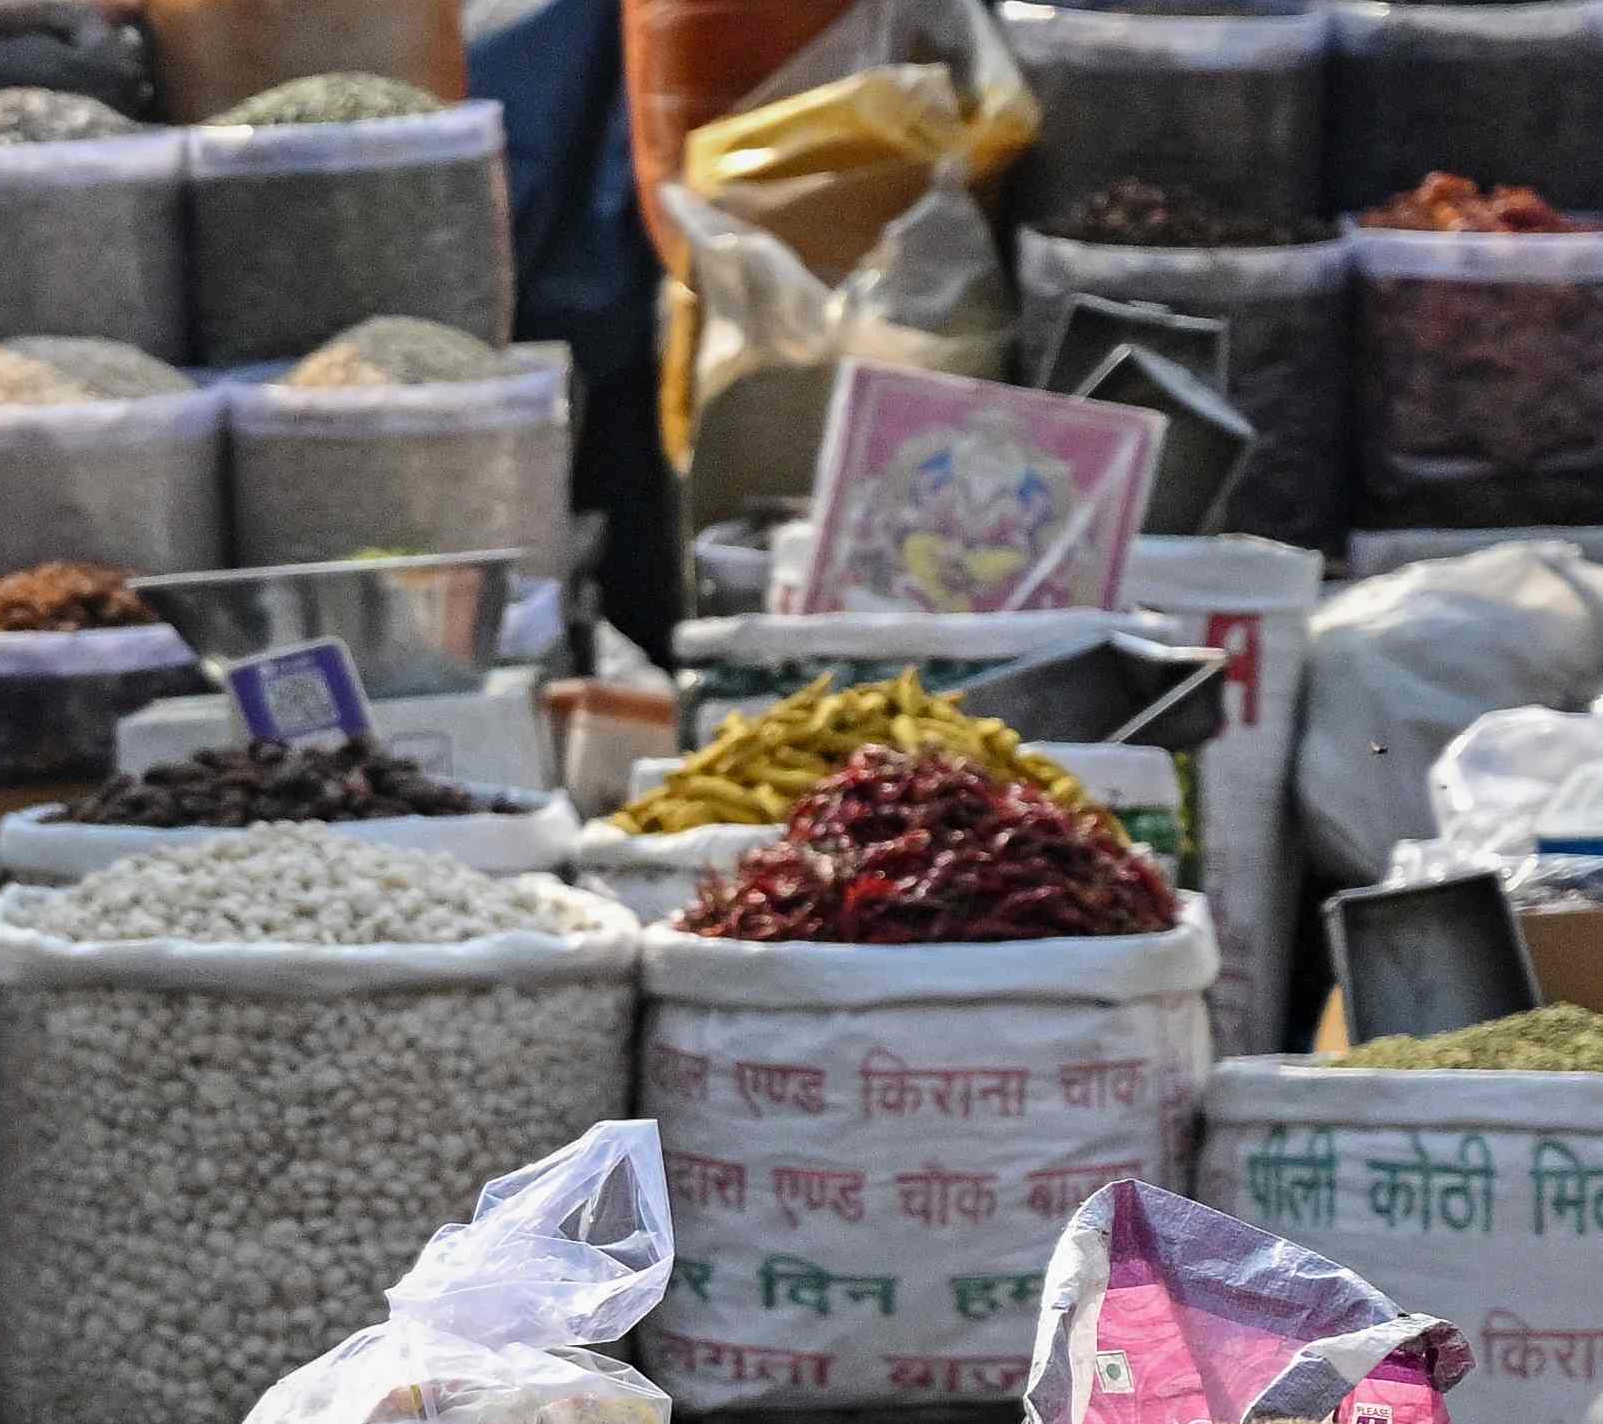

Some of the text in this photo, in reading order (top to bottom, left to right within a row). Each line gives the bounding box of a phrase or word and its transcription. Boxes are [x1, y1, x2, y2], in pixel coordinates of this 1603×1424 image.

[1364, 1131, 1494, 1231] कोठी
[1531, 1137, 1603, 1234] मि
[1356, 1405, 1392, 1418] PLEASE
